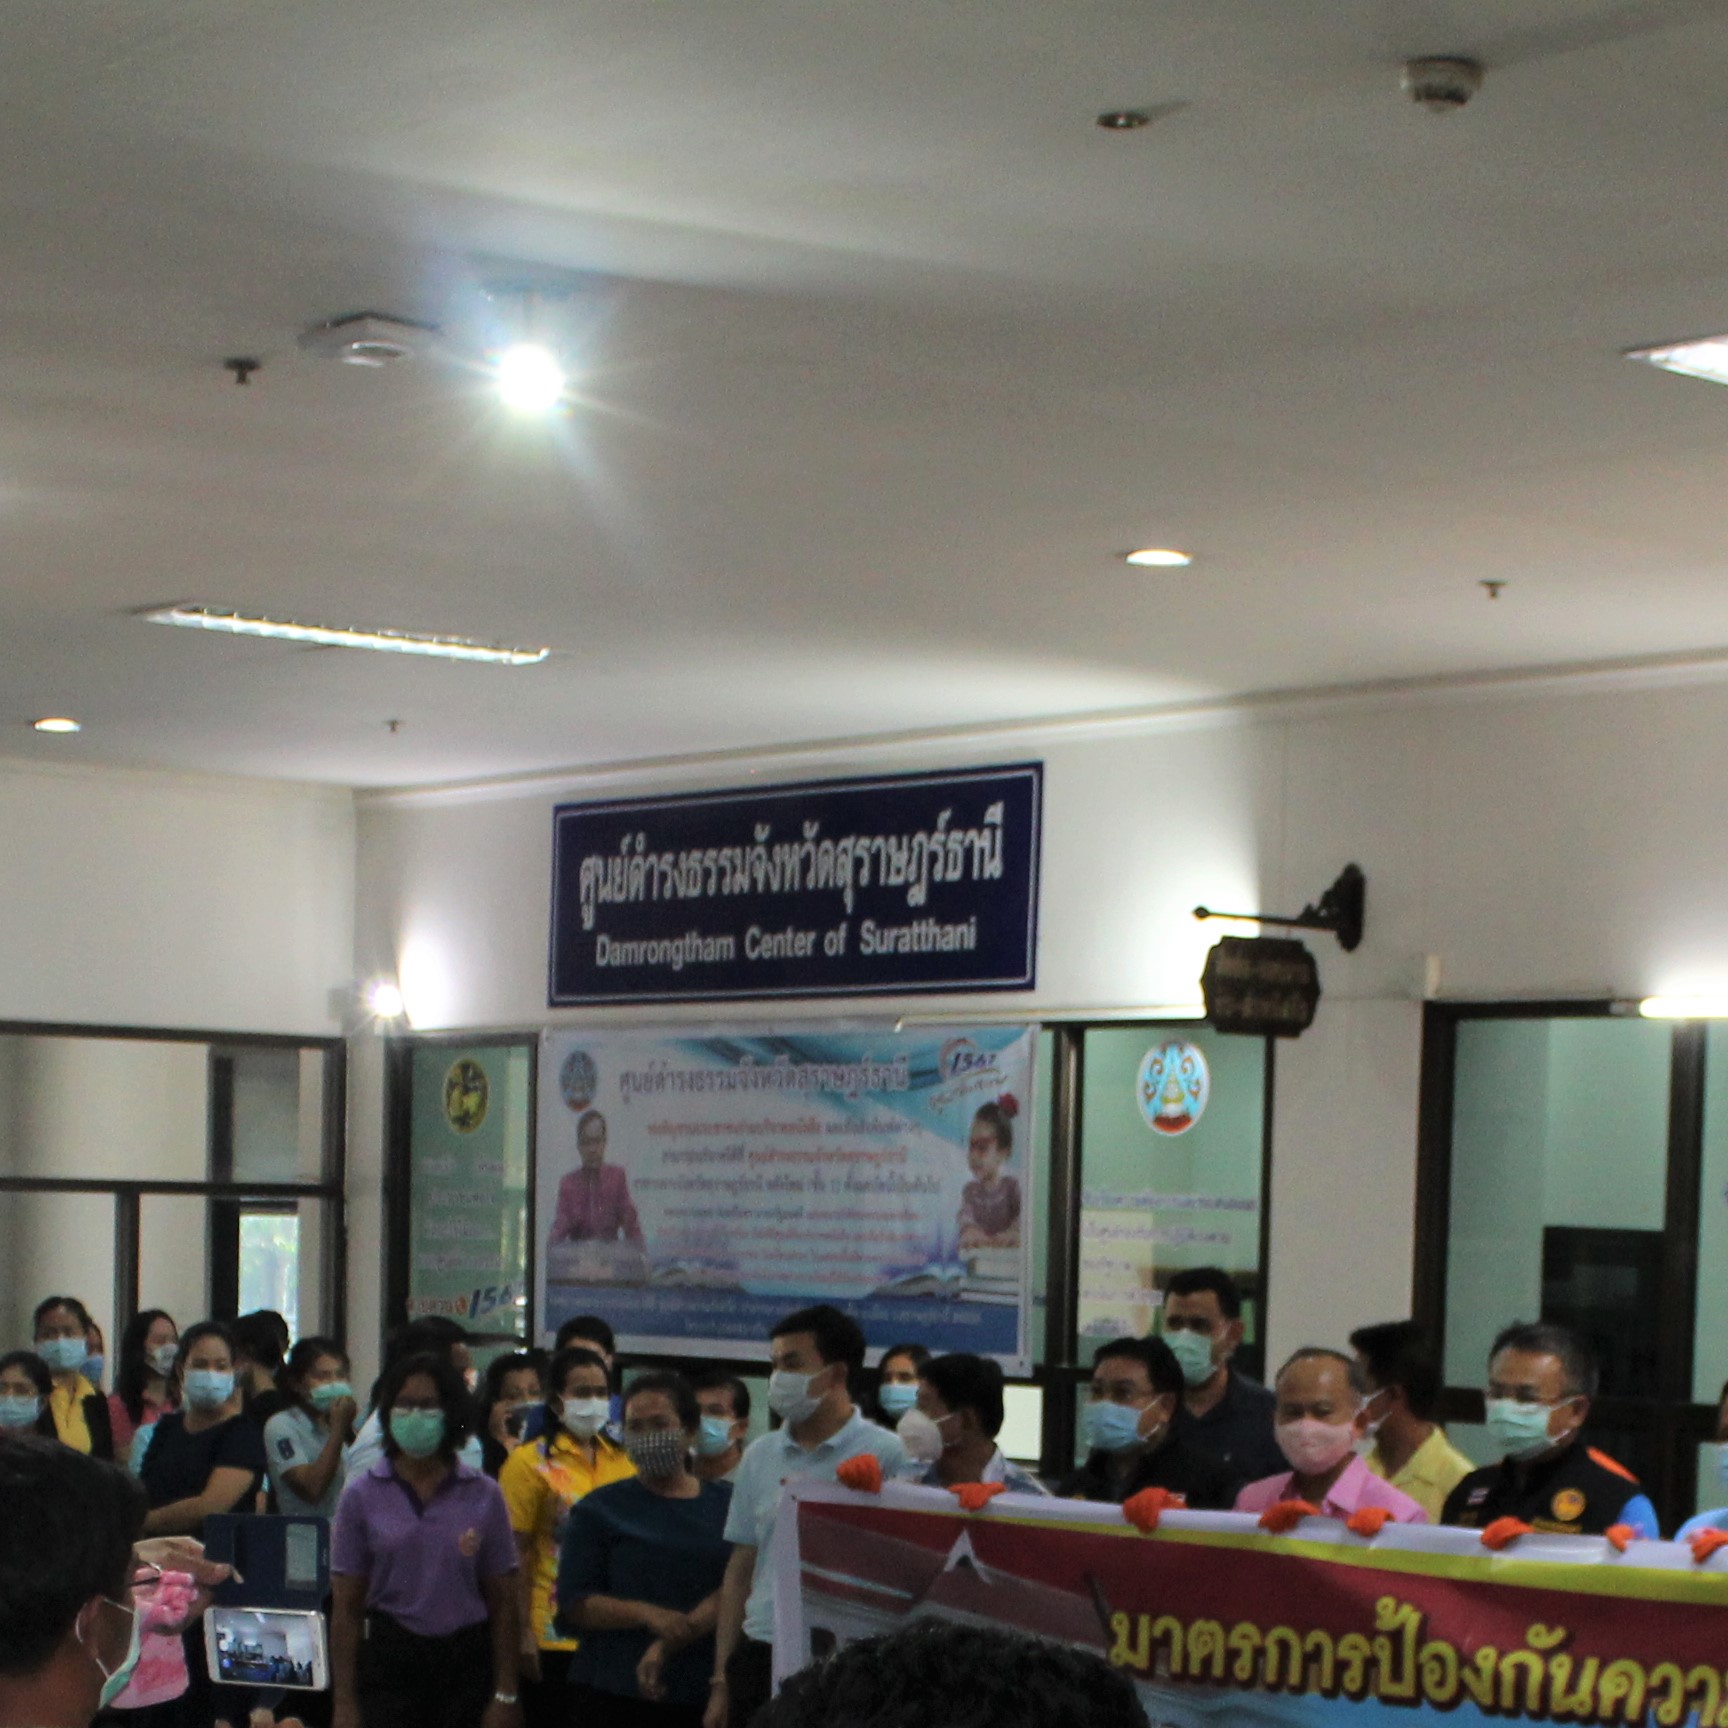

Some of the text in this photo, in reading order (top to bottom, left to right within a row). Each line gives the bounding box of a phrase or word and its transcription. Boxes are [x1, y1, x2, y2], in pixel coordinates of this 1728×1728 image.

[579, 801, 1004, 930] ศูนย์ดำรงธรรมจังหวัดสุราษฎร์ธานี
[595, 916, 977, 972] Damrongtham Center of Suratthani
